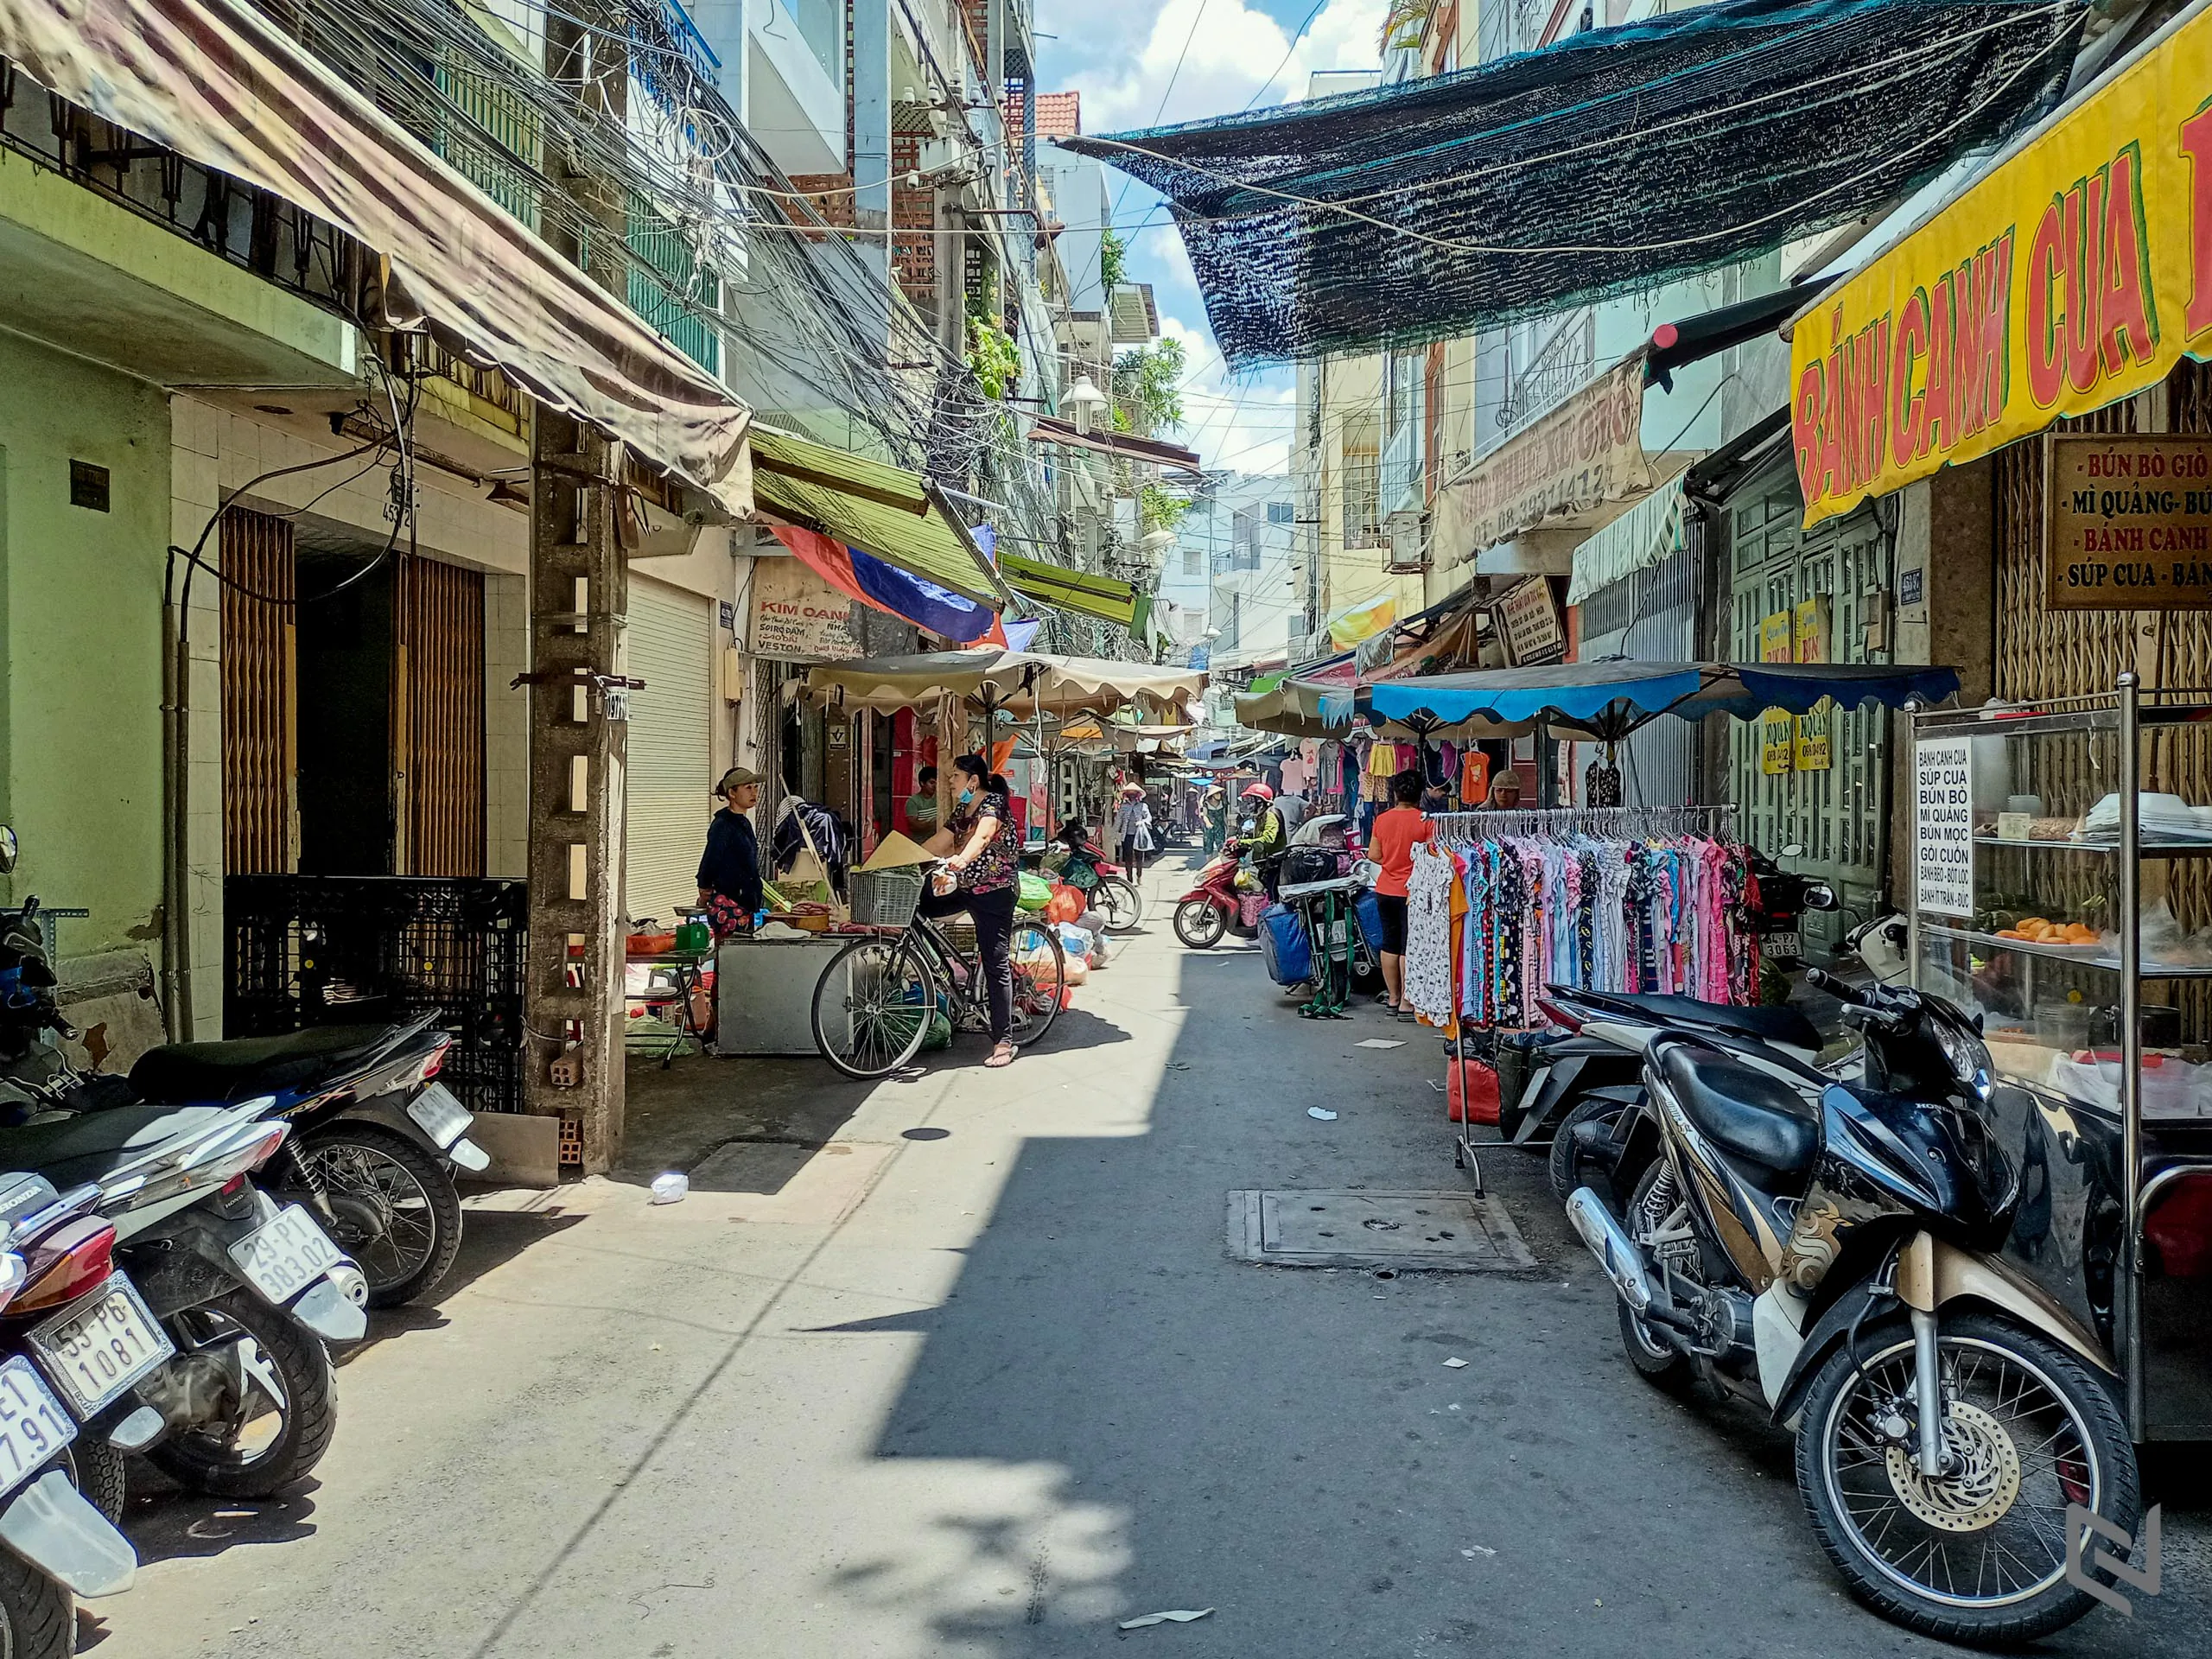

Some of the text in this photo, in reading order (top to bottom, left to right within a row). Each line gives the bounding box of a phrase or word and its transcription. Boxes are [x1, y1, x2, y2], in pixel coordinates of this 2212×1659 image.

[1794, 302, 1891, 510] BÁNH
[1891, 224, 2016, 470] CANH
[2027, 140, 2160, 410] CUA
[2088, 447, 2209, 478] BÚN BÒ GIÒ
[2072, 483, 2095, 514] MÌ
[2084, 521, 2209, 552] BÁNH CANH
[2068, 556, 2108, 588] SÚP
[2113, 563, 2157, 588] CUA
[760, 601, 798, 615] KIM
[1919, 748, 1967, 766] BÁNH CANH CUA
[1920, 768, 1967, 785] SÚP CUA
[1920, 785, 1967, 804] BÚN BÒ
[1920, 805, 1967, 823] MÌ QUẢNG
[1920, 823, 1967, 844] BÚN MỌC
[1767, 944, 1798, 956] 3063
[260, 1236, 334, 1296] 383.02
[79, 1327, 146, 1389] 1081
[0, 1402, 65, 1486] 7.91
